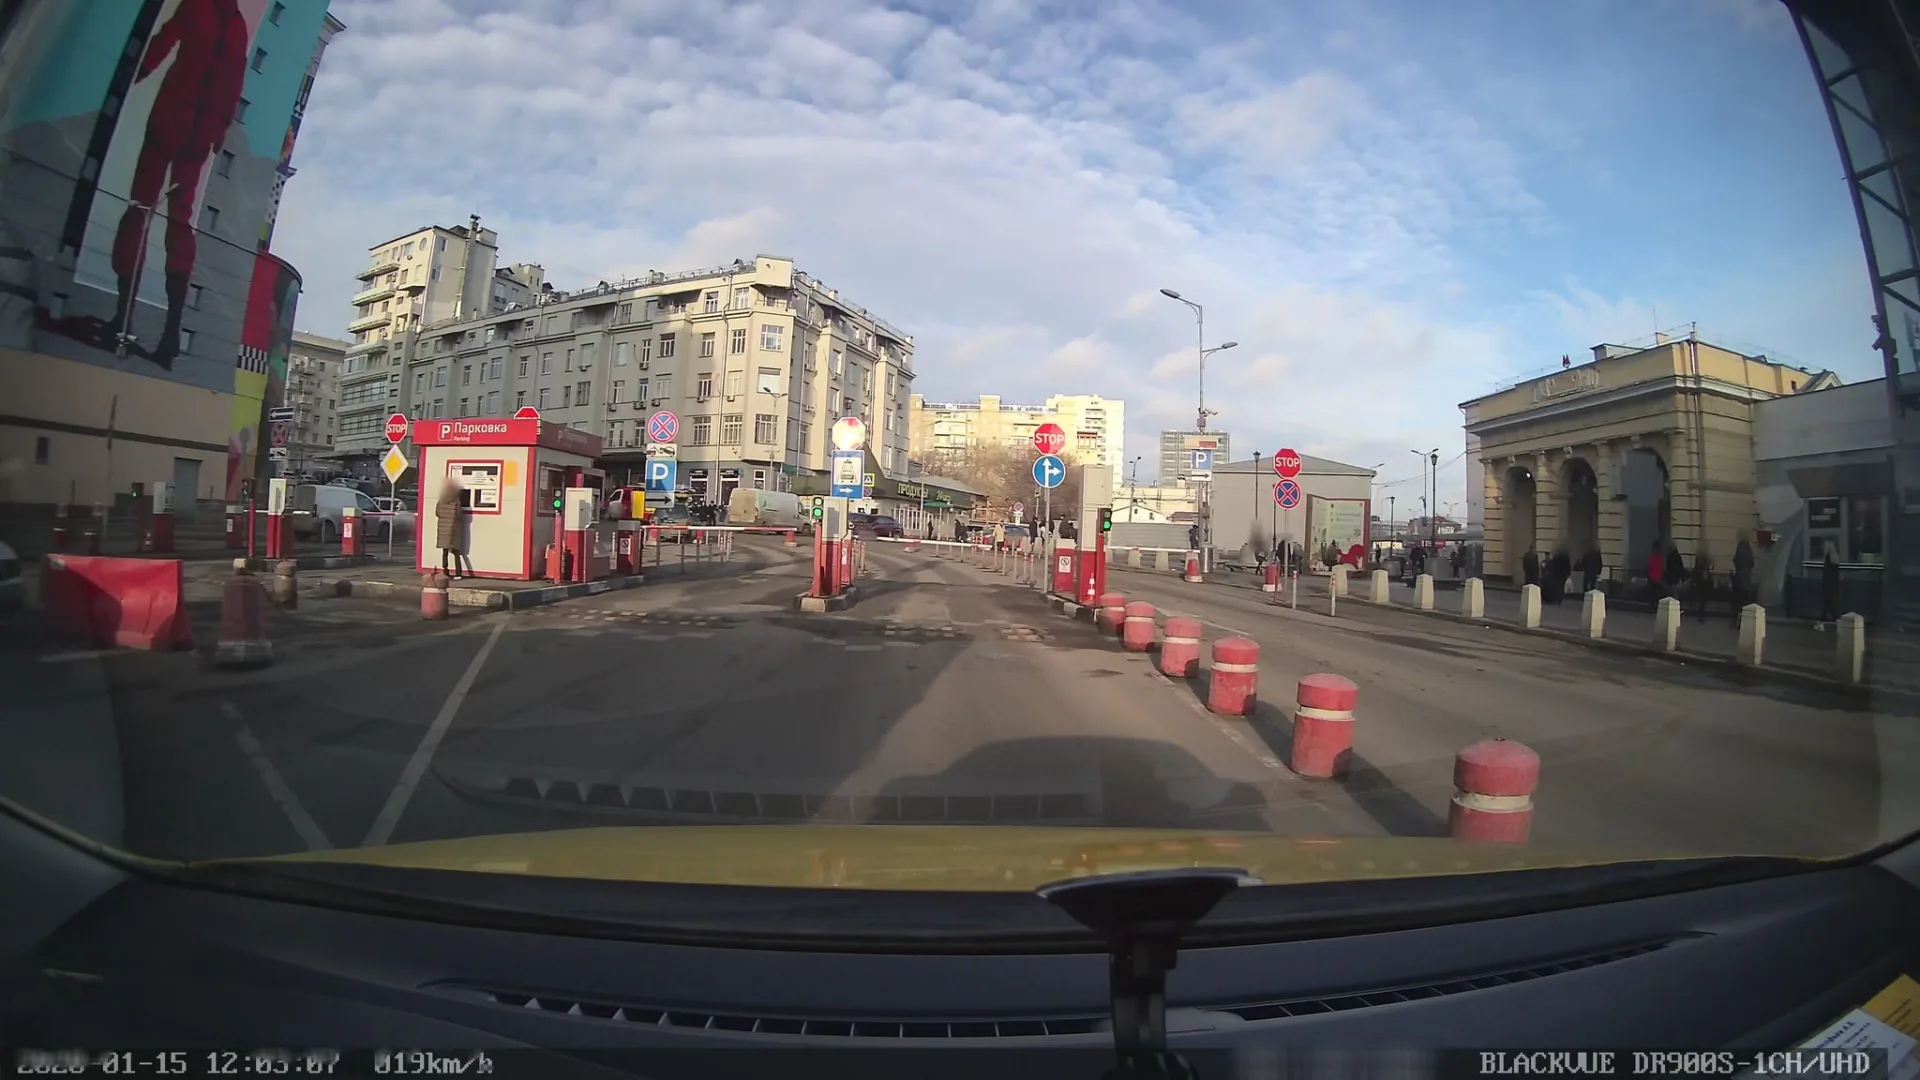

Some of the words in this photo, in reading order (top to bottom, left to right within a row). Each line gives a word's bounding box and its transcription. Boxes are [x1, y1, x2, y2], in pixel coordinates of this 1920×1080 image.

[387, 424, 406, 433] STOP
[441, 425, 451, 439] P
[454, 422, 507, 436] Парковка
[1035, 433, 1064, 445] STOP
[1195, 452, 1207, 468] P
[1275, 457, 1300, 467] STOP
[652, 463, 669, 488] P
[898, 482, 929, 498] ПРОДУКЫ
